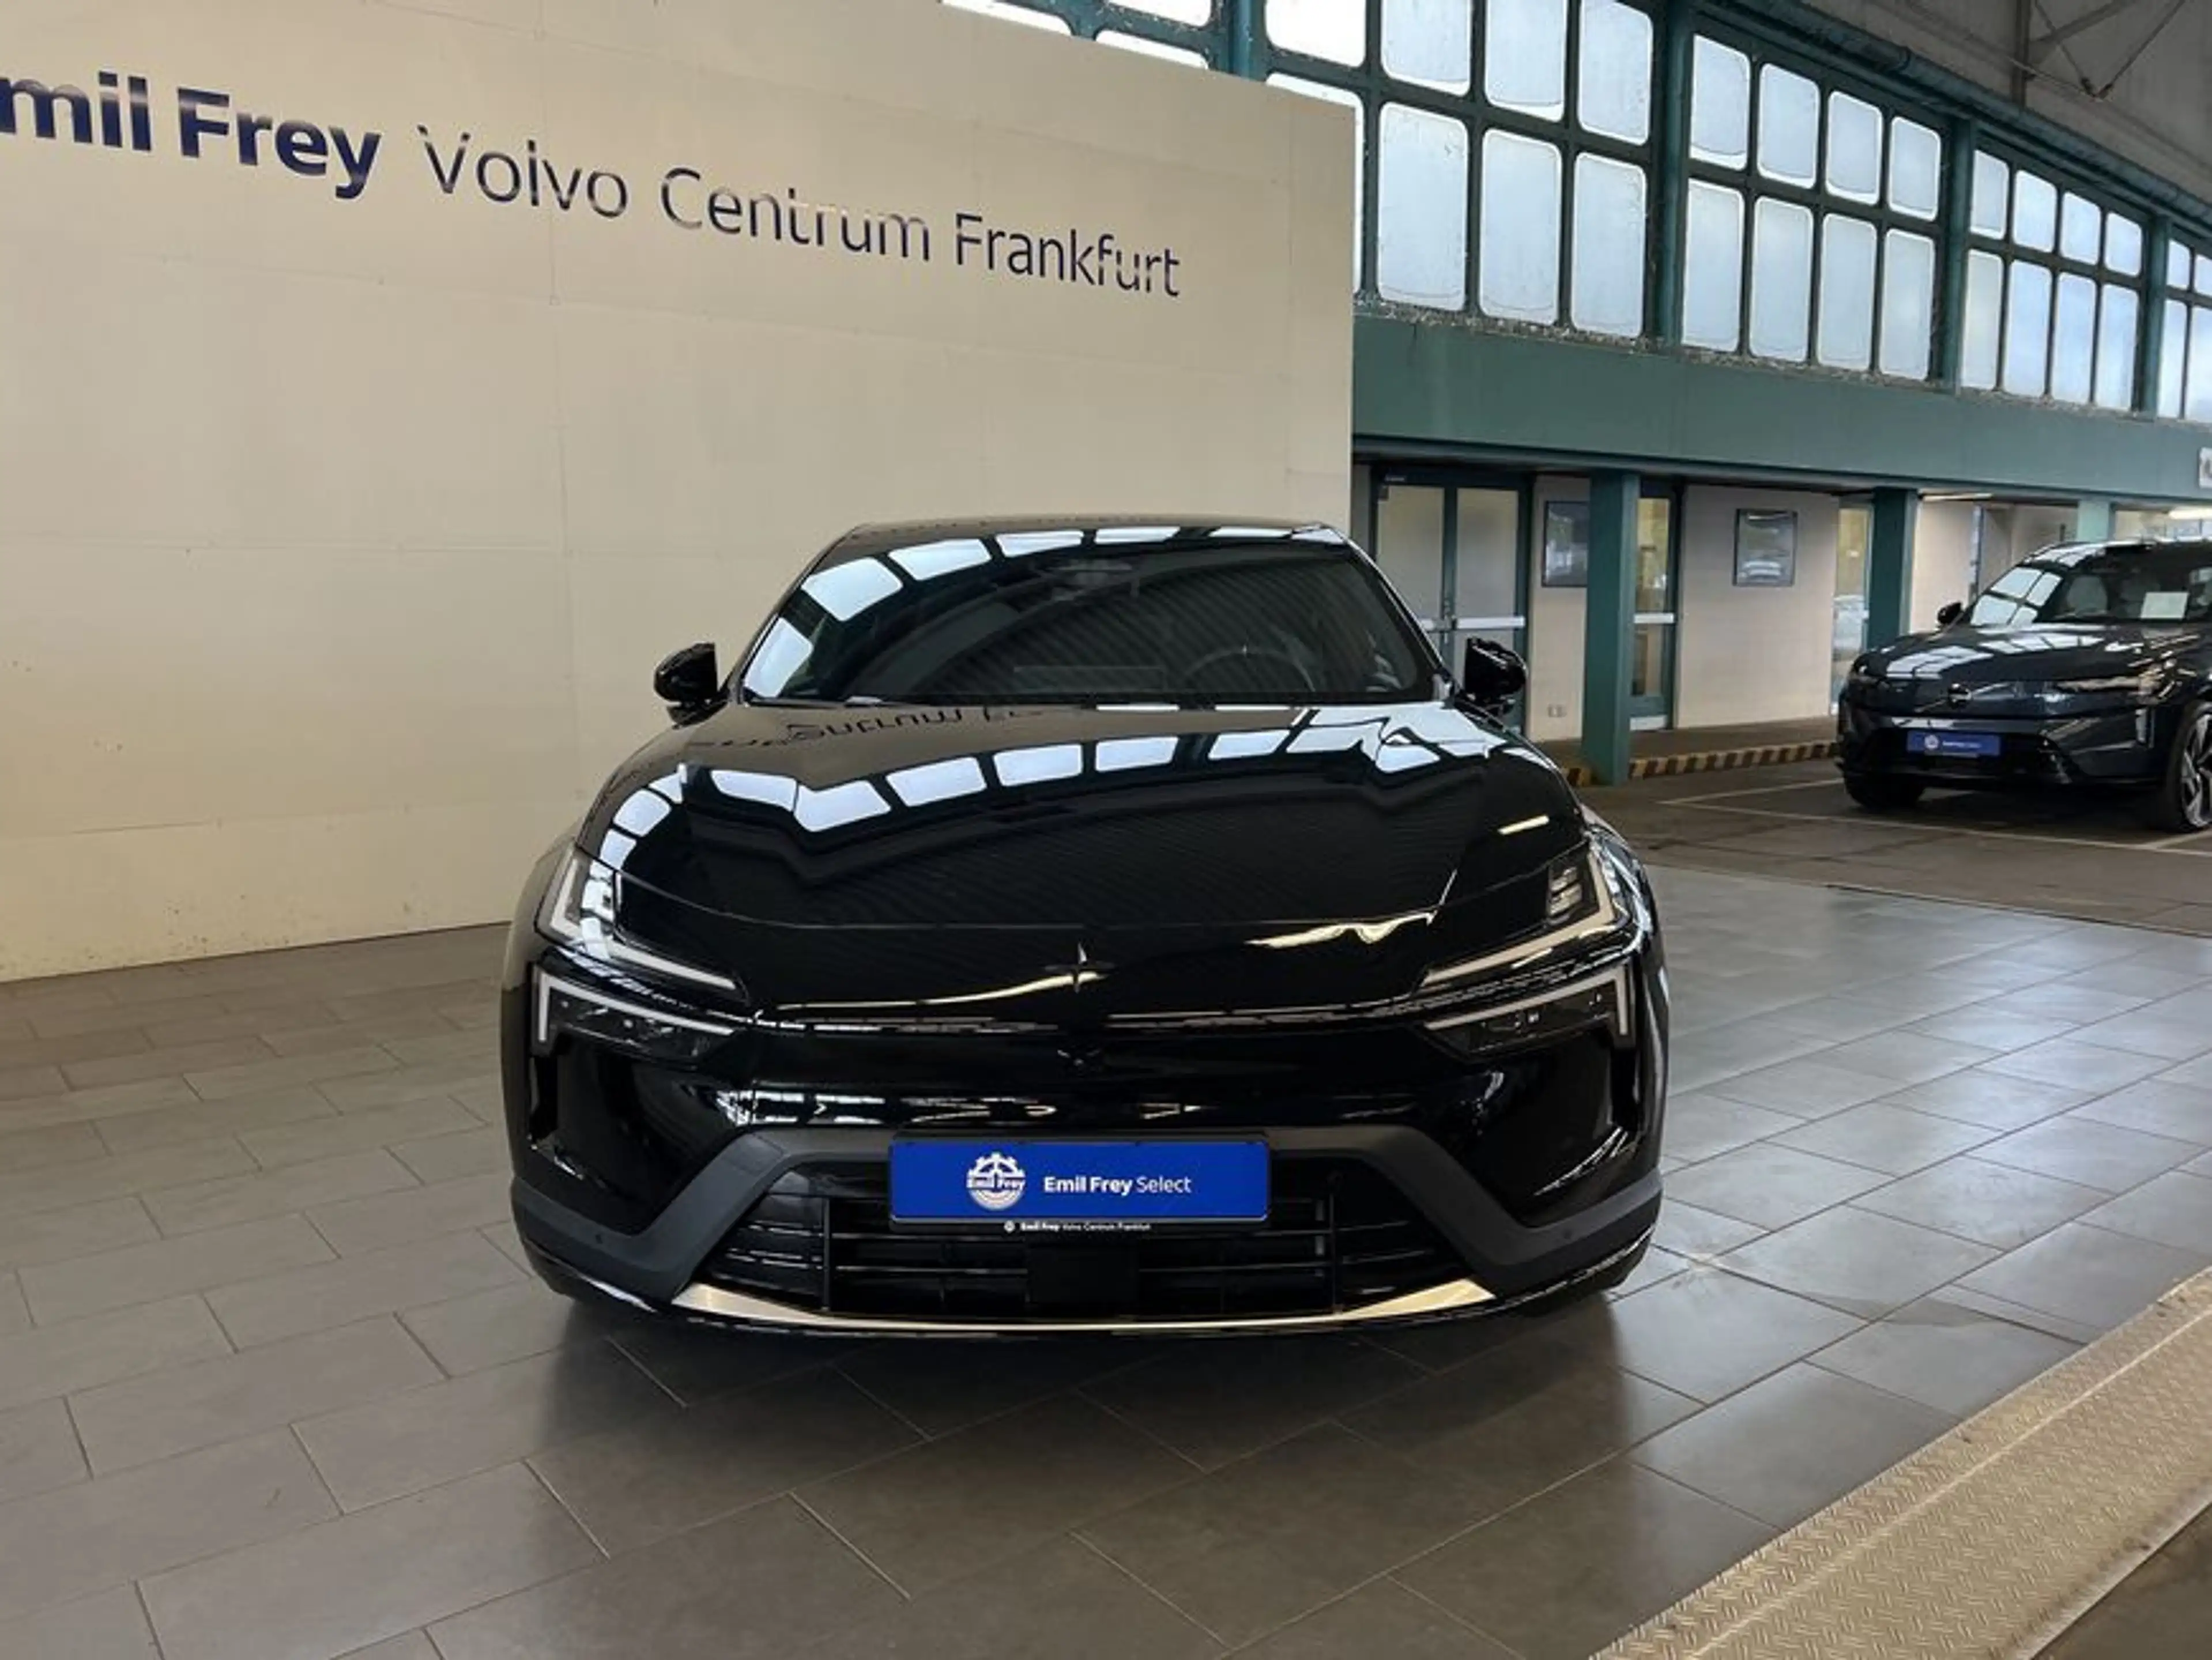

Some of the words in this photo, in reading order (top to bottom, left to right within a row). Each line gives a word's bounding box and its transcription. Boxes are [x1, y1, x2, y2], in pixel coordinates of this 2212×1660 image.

[177, 86, 381, 199] Frey
[661, 166, 930, 261] Centrum
[955, 213, 1181, 296] Frankfurt
[1043, 1175, 1087, 1193] Emil
[1090, 1176, 1133, 1196] Frey
[1135, 1175, 1192, 1194] Select
